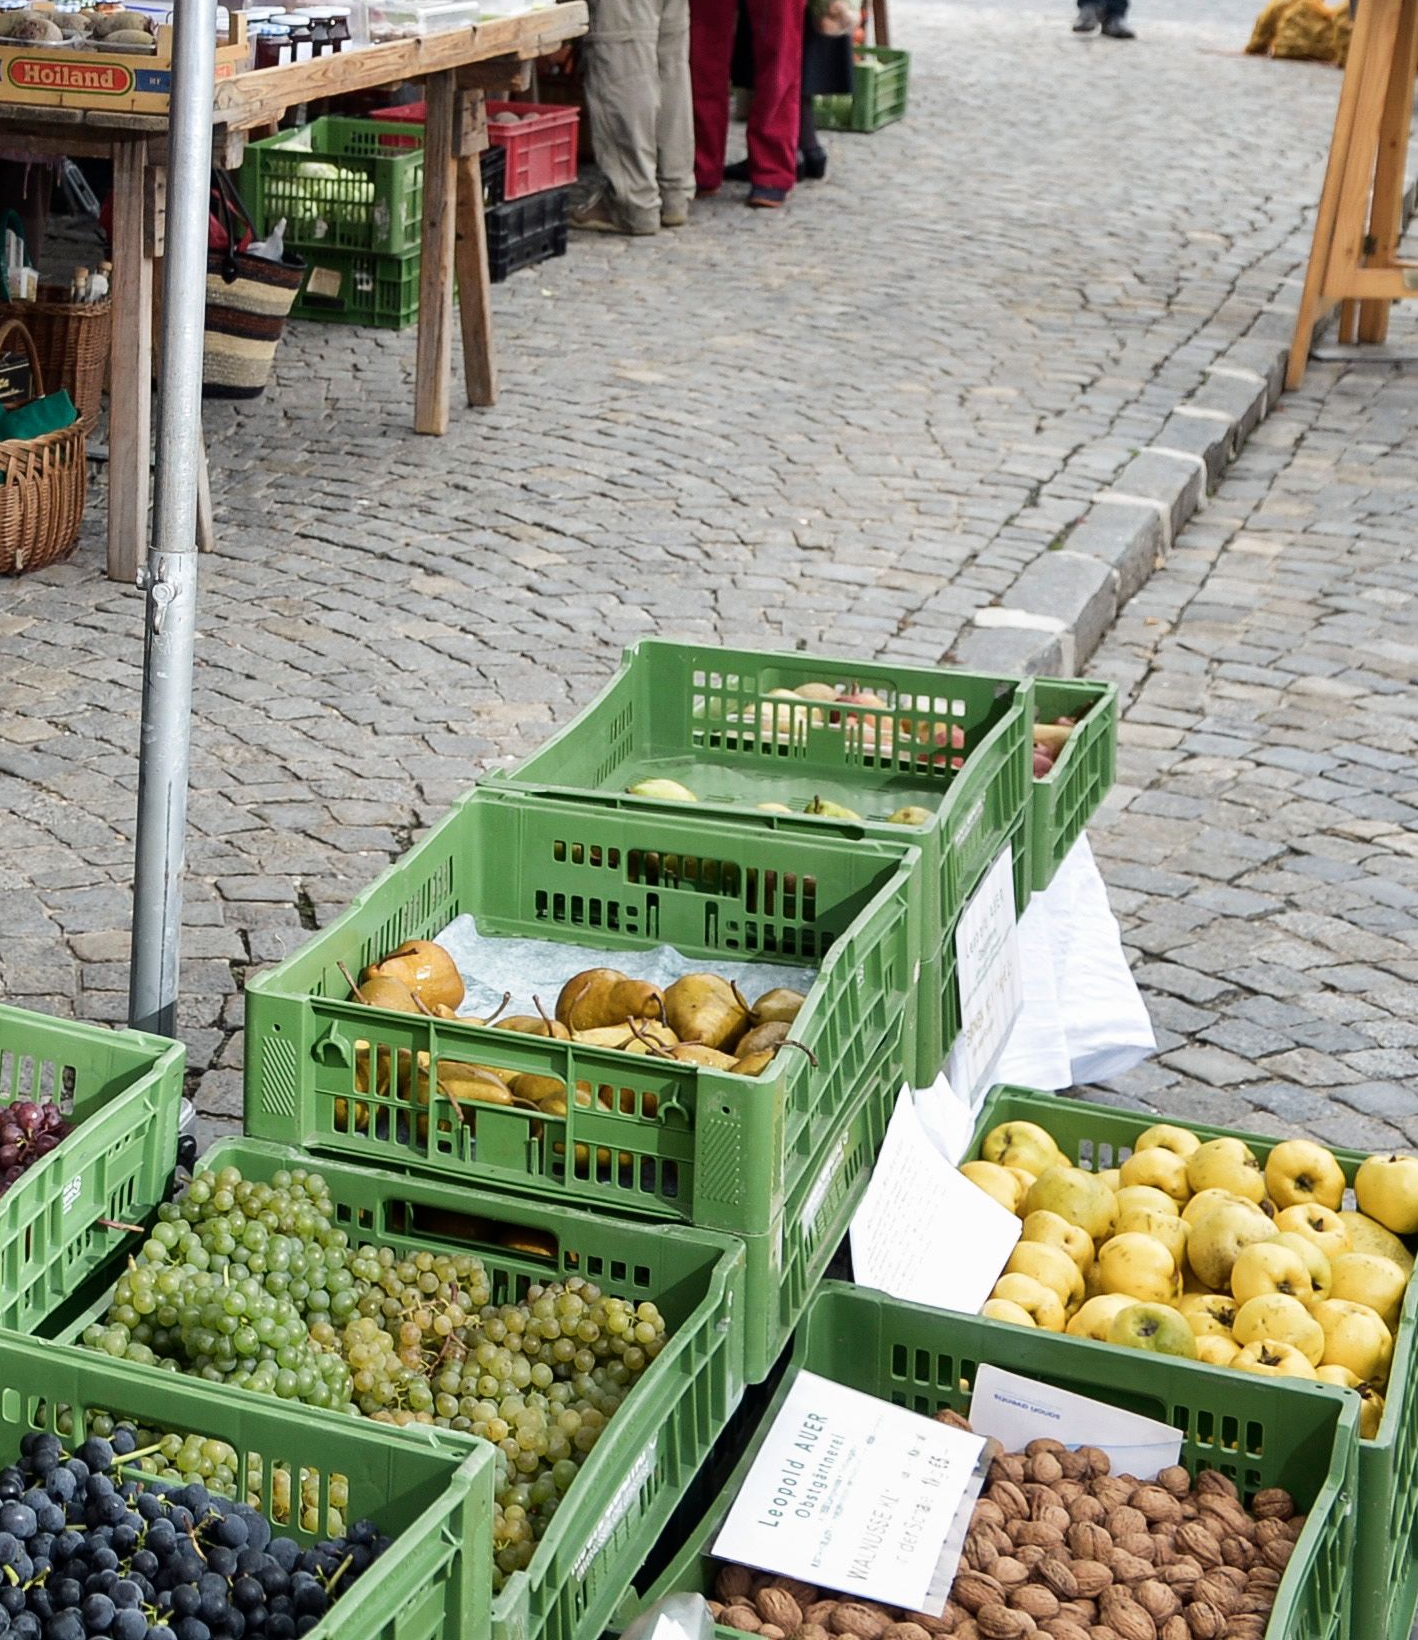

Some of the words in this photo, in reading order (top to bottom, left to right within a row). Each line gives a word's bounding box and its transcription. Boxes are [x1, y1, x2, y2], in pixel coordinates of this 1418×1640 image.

[757, 1458, 806, 1529] Leopold
[794, 1411, 829, 1454] AUER
[795, 1433, 846, 1520] Obstgärtnerei
